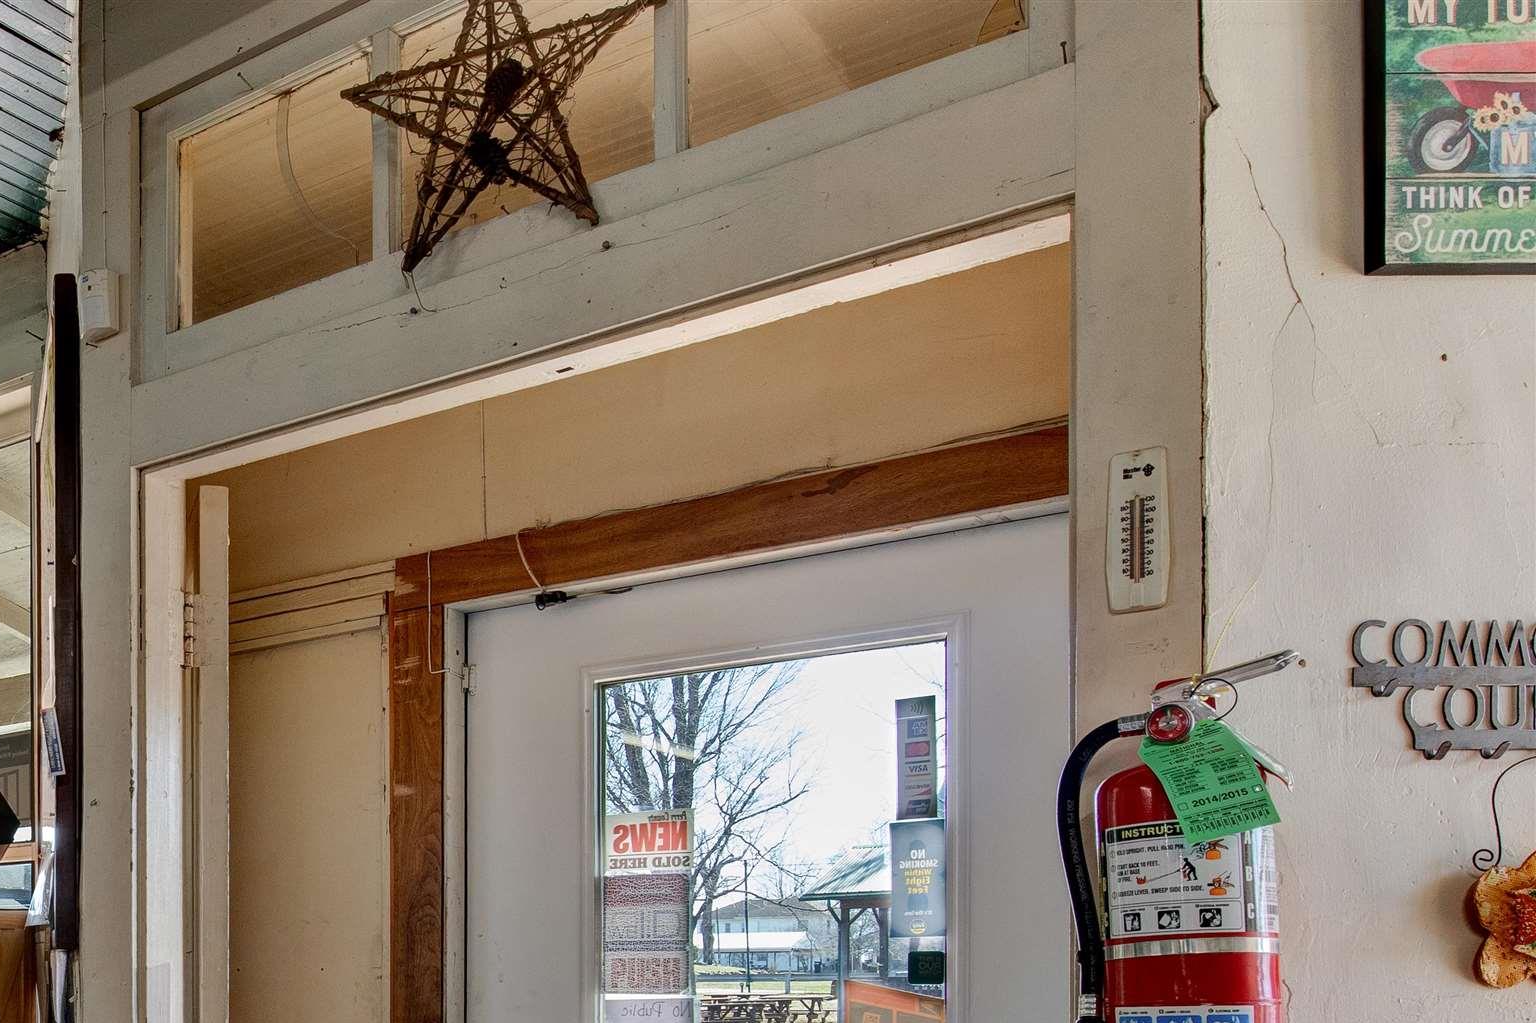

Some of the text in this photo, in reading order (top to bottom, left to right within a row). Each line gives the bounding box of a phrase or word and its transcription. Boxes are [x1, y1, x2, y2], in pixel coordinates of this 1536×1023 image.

[1500, 131, 1536, 166] M
[1402, 186, 1532, 209] THINK OF
[1352, 619, 1536, 668] COMM
[1403, 685, 1536, 731] COU
[1192, 788, 1249, 808] 2014/2015
[1121, 825, 1183, 839] INSTRUCT
[1244, 831, 1251, 845] A
[1245, 865, 1252, 881] B
[1246, 902, 1255, 920] C
